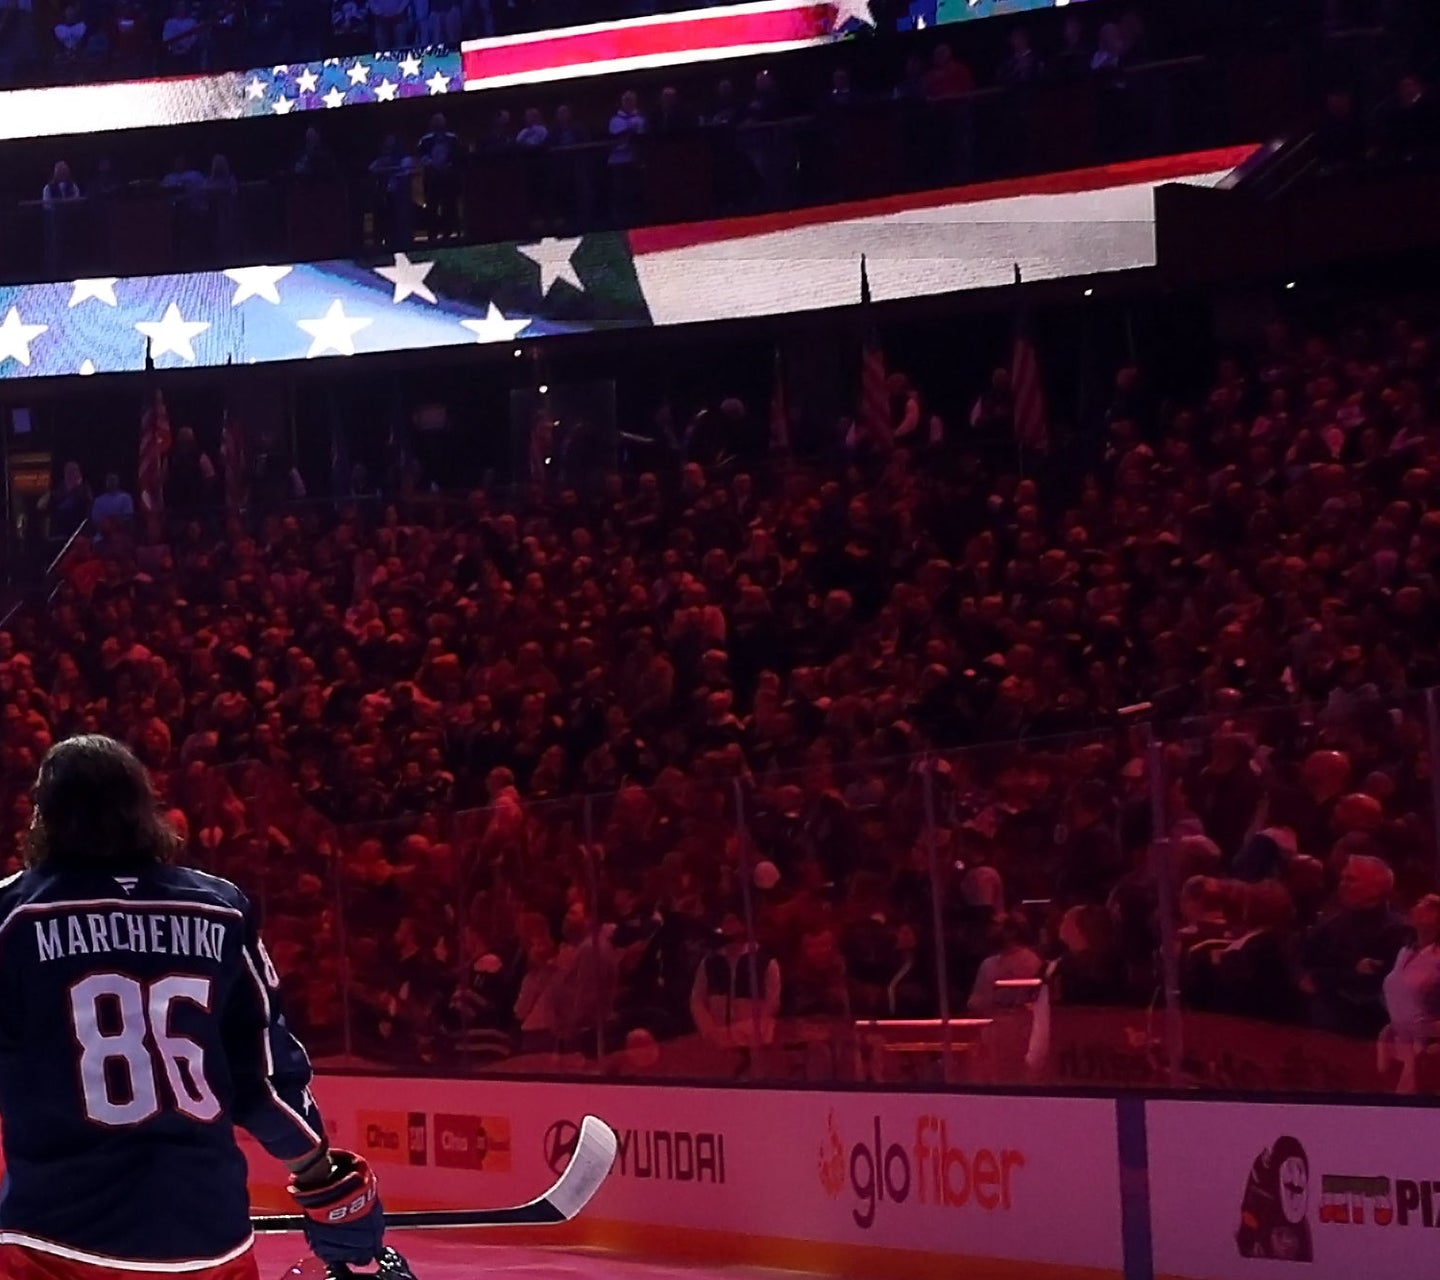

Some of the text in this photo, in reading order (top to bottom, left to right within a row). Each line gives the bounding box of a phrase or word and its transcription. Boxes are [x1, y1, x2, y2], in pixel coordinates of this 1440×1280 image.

[33, 911, 227, 964] MARCHENKO
[68, 970, 225, 1129] 86
[610, 1128, 725, 1184] YUNDAI
[850, 1114, 1025, 1229] glo fiber
